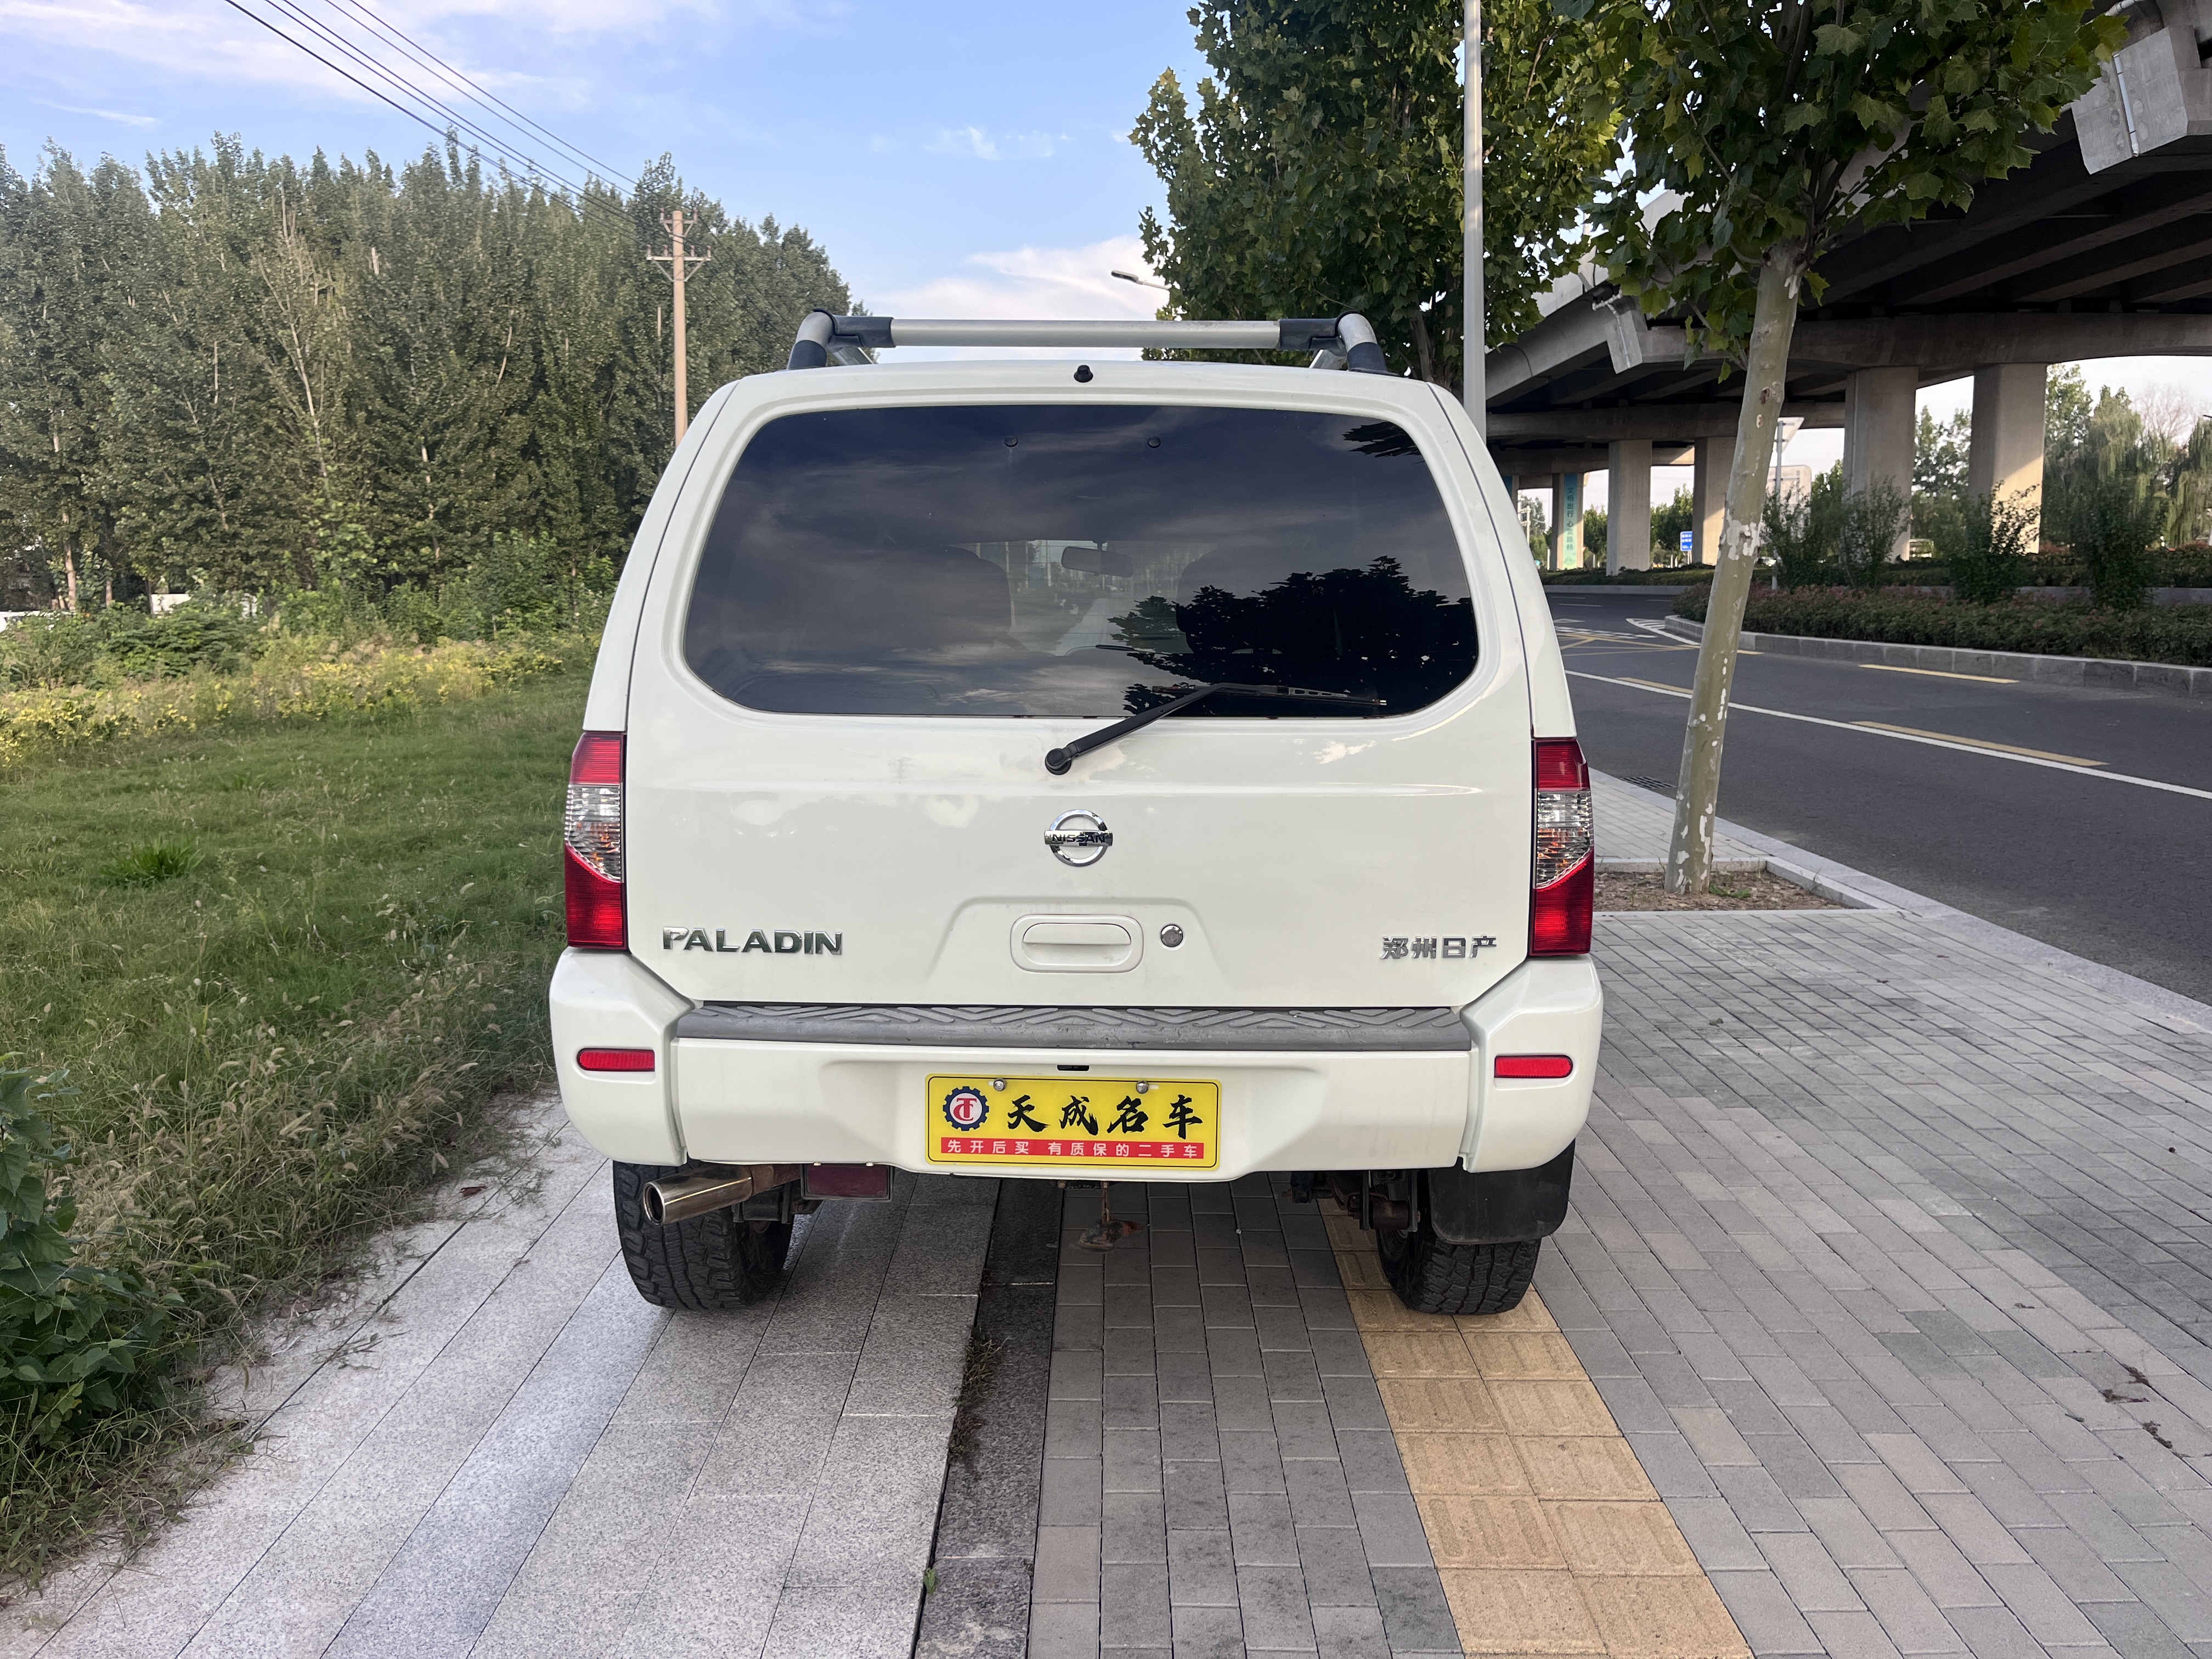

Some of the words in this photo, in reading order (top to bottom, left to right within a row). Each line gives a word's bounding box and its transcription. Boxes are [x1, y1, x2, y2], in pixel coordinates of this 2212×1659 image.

[1052, 834, 1105, 843] NISSAN
[663, 926, 843, 956] PALADIN
[1380, 934, 1497, 960] 郑州日产
[1007, 1094, 1203, 1139] 天成名车
[947, 1139, 1029, 1155] 先开后买
[1048, 1141, 1198, 1159] 有质保的二手车
